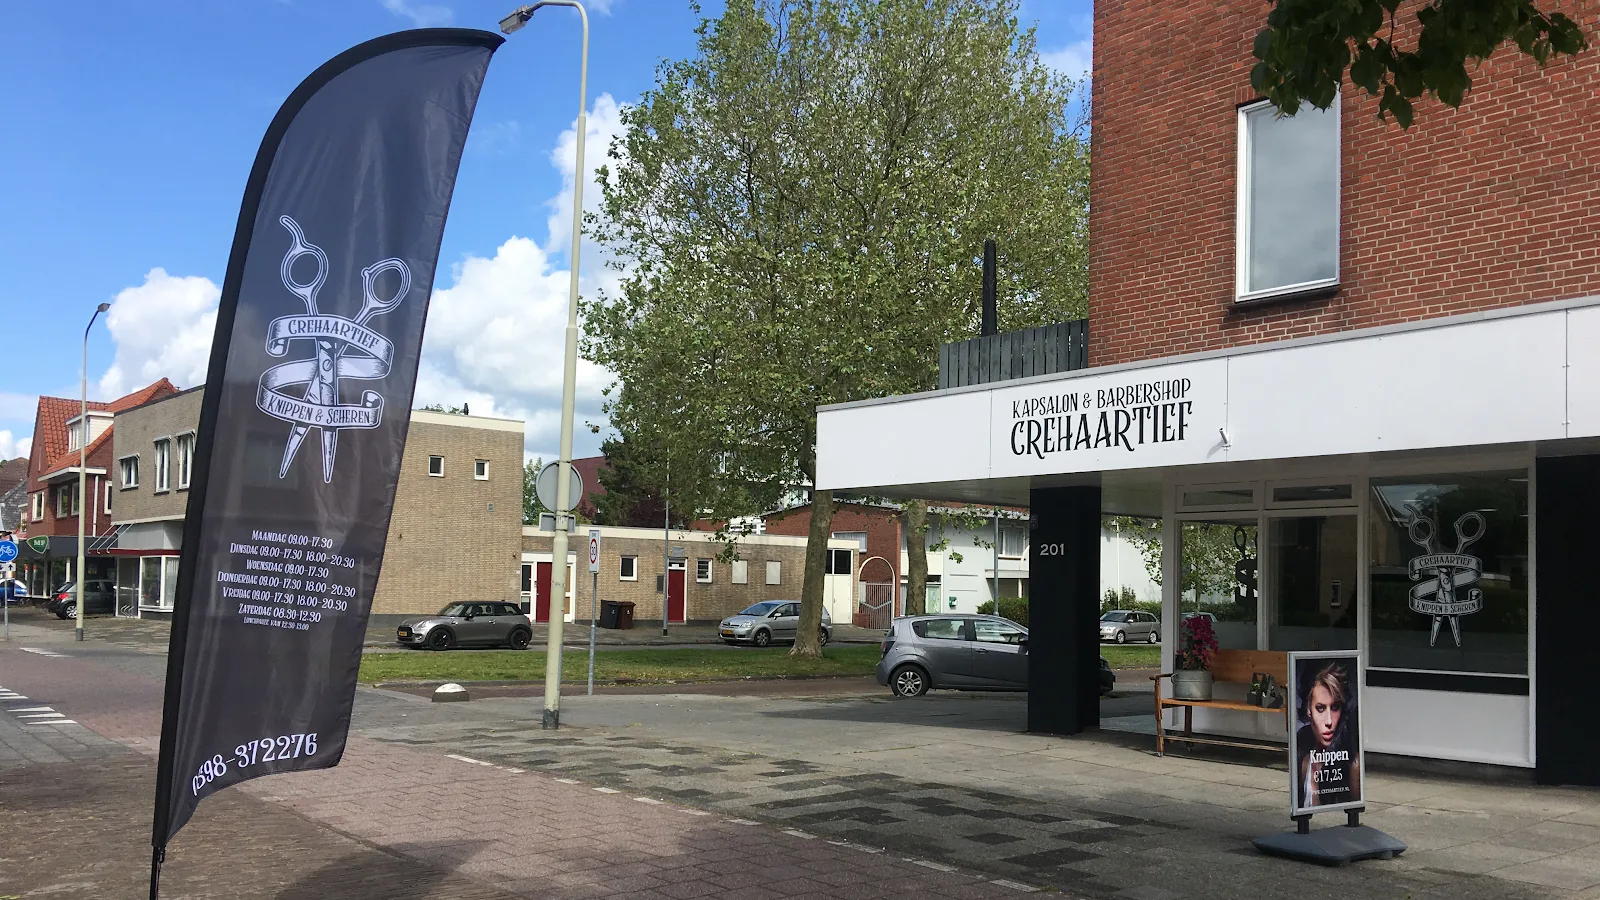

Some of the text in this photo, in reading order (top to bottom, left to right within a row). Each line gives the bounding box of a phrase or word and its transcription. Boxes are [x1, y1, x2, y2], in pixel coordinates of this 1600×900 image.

[288, 318, 379, 350] CREHAARTIEF
[1012, 378, 1190, 418] KAPSALON & BARBERSHOP
[267, 396, 370, 424] KNIPPEN & SCHEREN
[1011, 401, 1193, 459] CREHAARTIEF
[252, 530, 332, 548] MAANDAG 09.00-17.30
[260, 546, 302, 560] 09.00-17.30
[306, 551, 355, 568] 18.00-20.30
[1040, 544, 1064, 555] 201
[1419, 556, 1473, 567] CREHAARTIEF
[285, 564, 329, 578] 09.00-17.30
[259, 576, 301, 590] 09.00-17.30
[305, 581, 356, 597] 18.00-20.30
[252, 590, 294, 604] 09.00-17.30
[297, 595, 347, 611] 18.00-20.30
[1416, 601, 1443, 613] KNIPPEN
[1450, 601, 1476, 613] SCHEREN
[274, 608, 321, 622] 08.30-12.30
[1310, 749, 1349, 766] Knippen
[1314, 768, 1343, 782] €17,25
